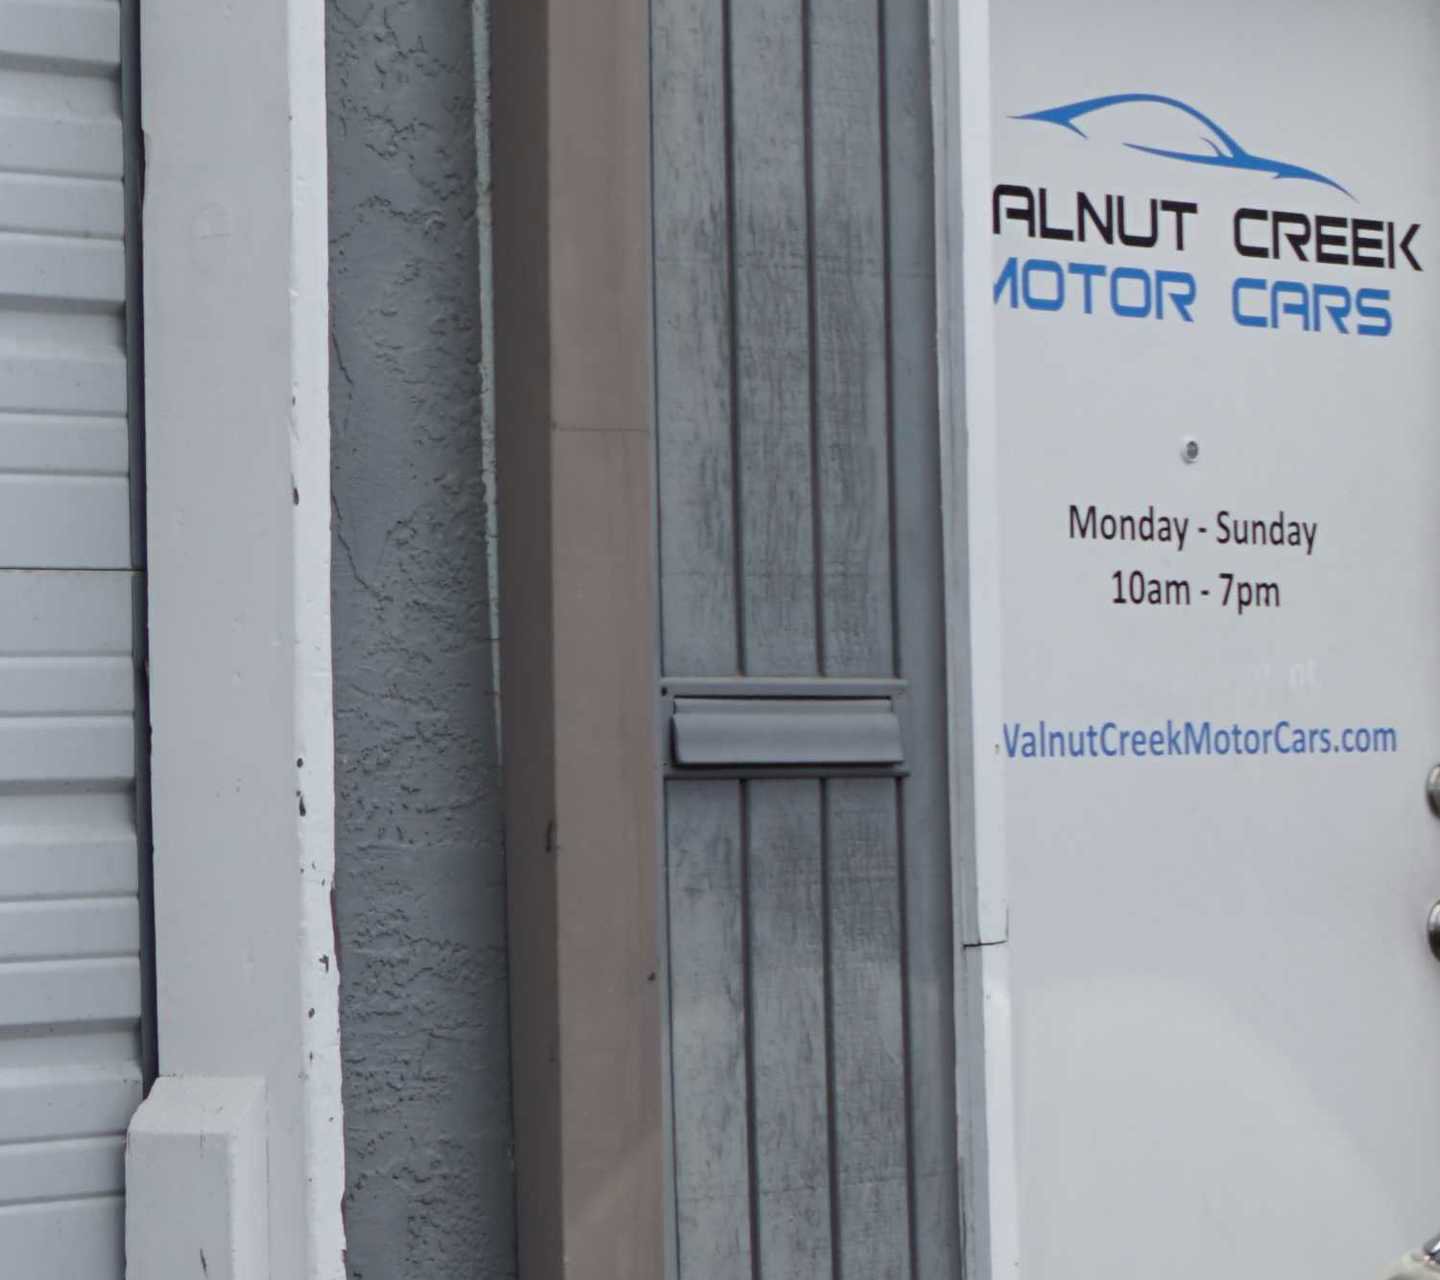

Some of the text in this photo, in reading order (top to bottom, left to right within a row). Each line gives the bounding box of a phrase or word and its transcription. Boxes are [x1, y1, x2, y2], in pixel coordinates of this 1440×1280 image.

[992, 183, 1424, 272] ALNUT CREEK
[1232, 277, 1393, 338] CARS
[1068, 504, 1190, 552] Monday
[1216, 509, 1318, 555] Sunday
[1111, 569, 1192, 607] 10am
[1218, 571, 1281, 615] 7pm
